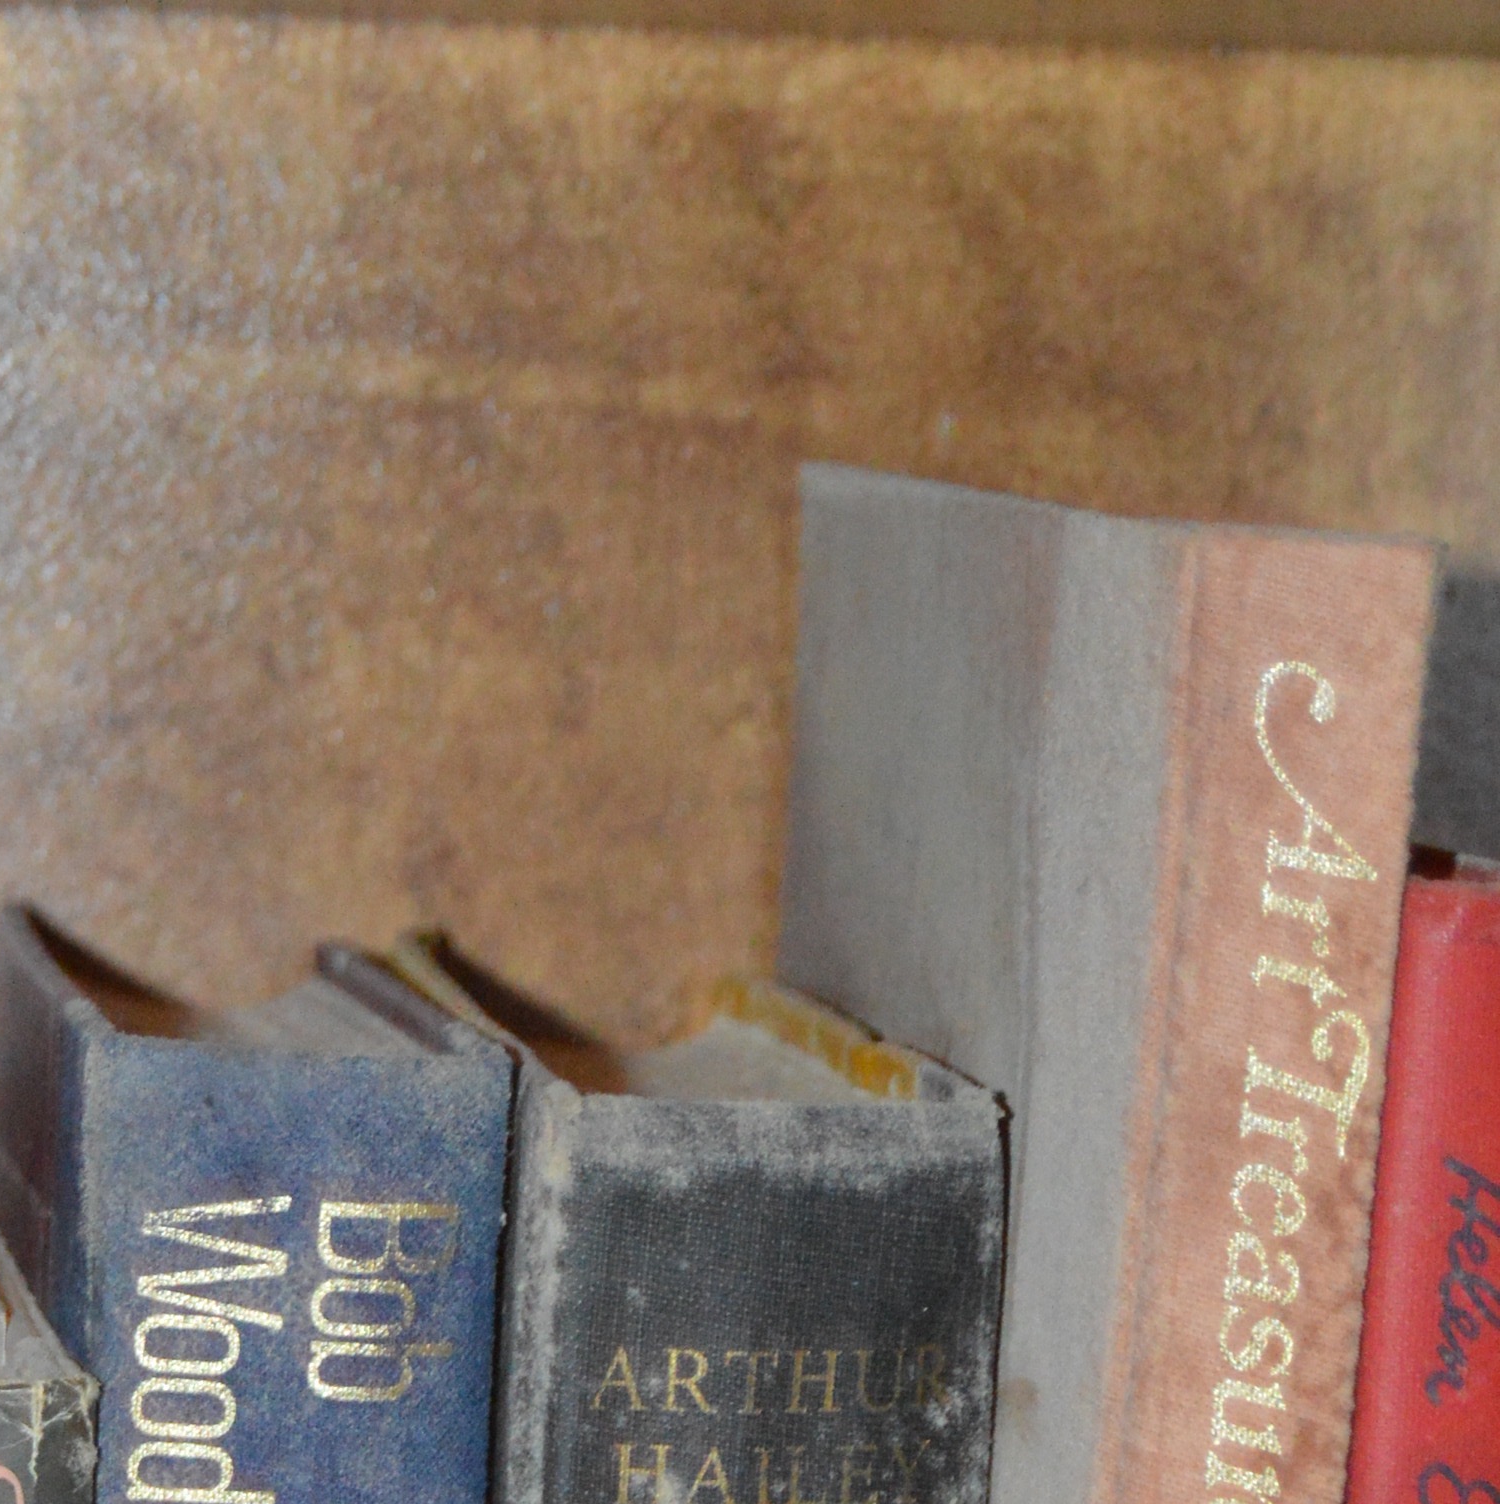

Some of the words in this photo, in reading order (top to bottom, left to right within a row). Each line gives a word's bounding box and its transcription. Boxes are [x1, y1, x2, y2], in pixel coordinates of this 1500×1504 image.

[1251, 659, 1379, 1008] Art
[306, 1199, 459, 1401] Bob
[591, 1345, 950, 1414] ARTHUR
[1425, 1155, 1500, 1406] Helen
